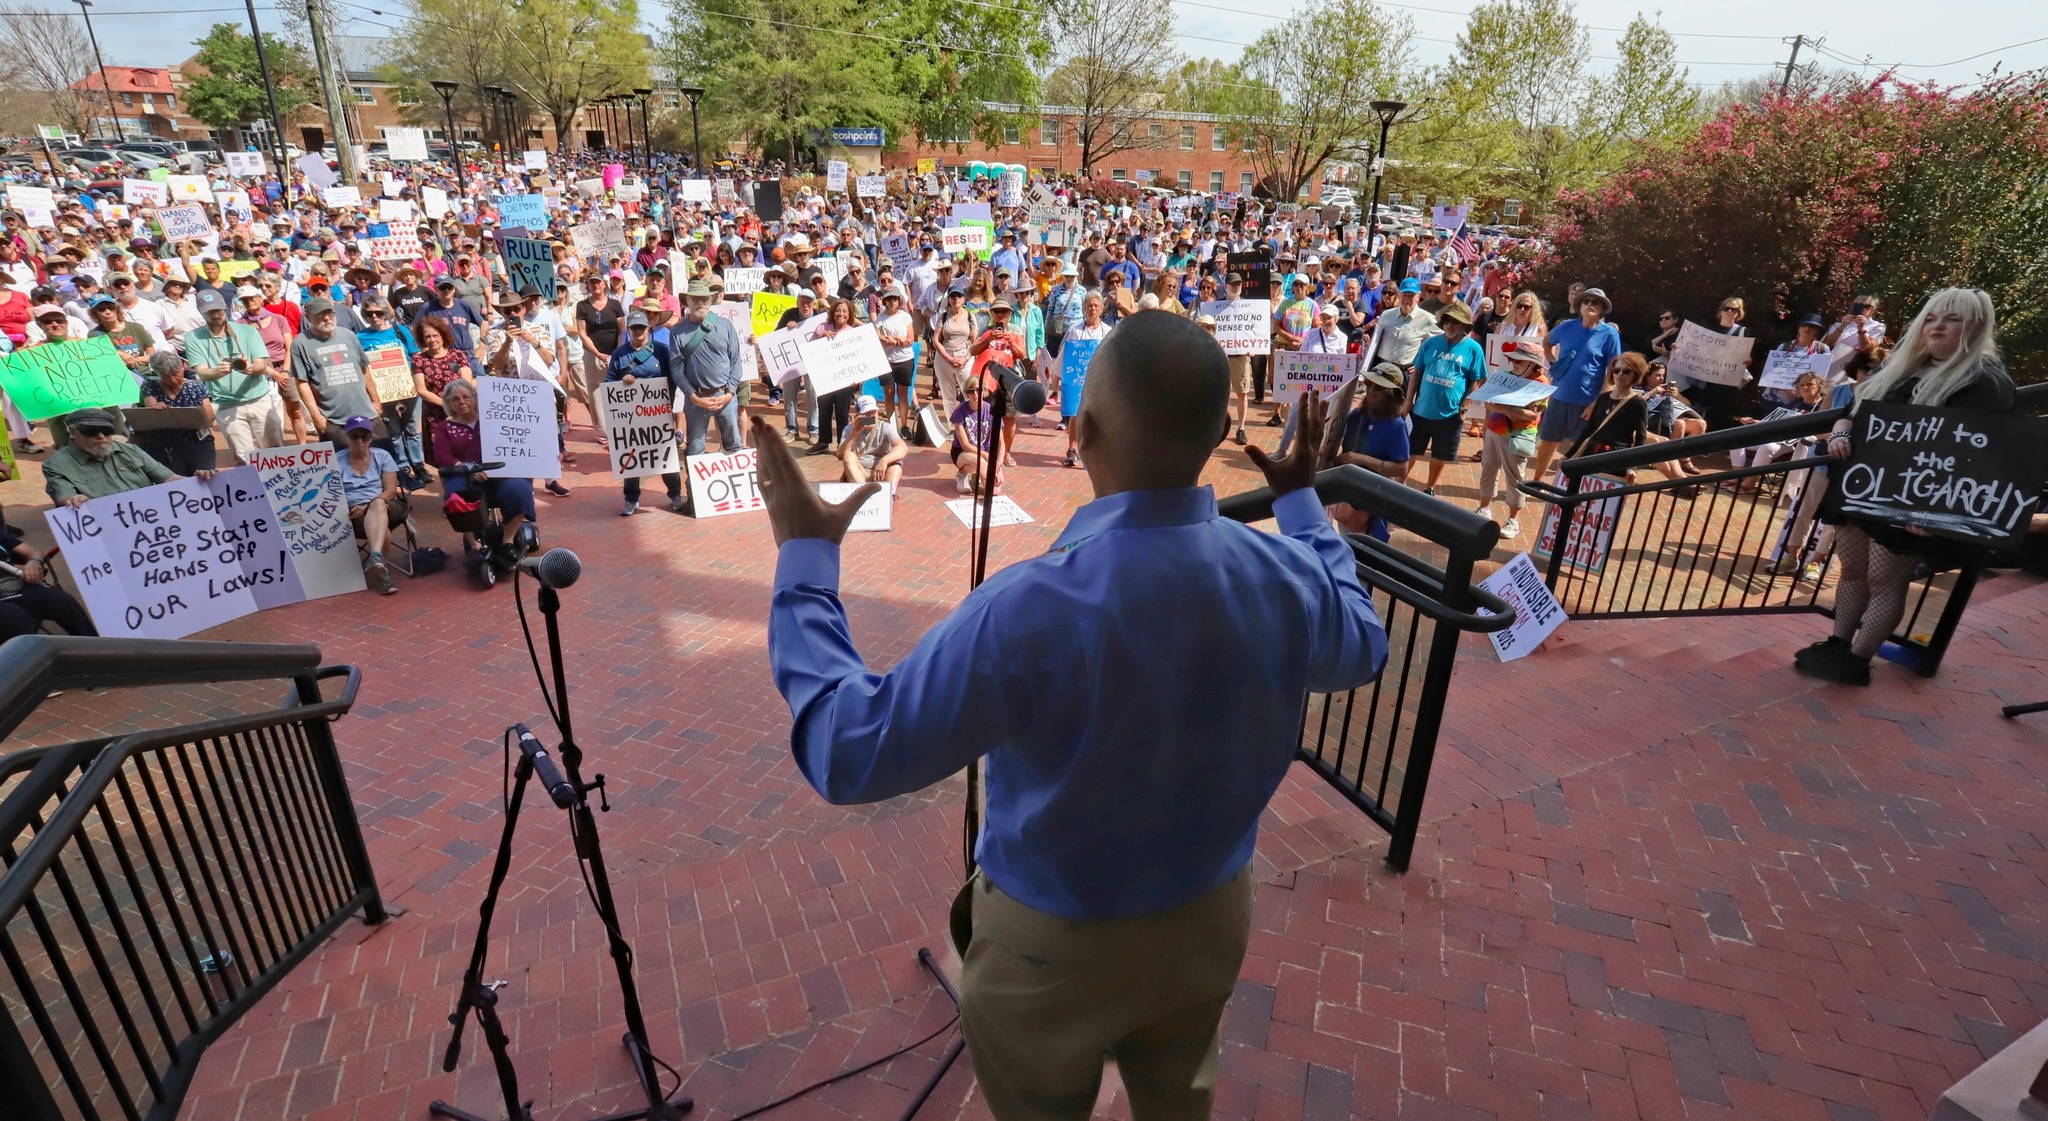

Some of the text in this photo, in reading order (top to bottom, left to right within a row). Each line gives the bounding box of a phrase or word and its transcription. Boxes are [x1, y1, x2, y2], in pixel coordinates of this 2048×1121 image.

[833, 130, 878, 142] cashpoints
[132, 191, 158, 199] NATO
[1000, 198, 1019, 206] VOTE
[161, 208, 196, 219] HANDS
[505, 203, 538, 213] DEPORT
[1031, 205, 1056, 215] HANDS
[169, 223, 207, 237] EDUCATION
[511, 218, 543, 227] FRIENDS
[945, 234, 983, 245] RESIST
[506, 240, 552, 261] RULE
[524, 264, 539, 275] of
[1230, 262, 1268, 270] DIVERSITY
[511, 273, 554, 298] LAW
[402, 297, 424, 305] Resist.
[1682, 321, 1727, 347] Morons
[1678, 335, 1700, 351] Are
[1, 335, 115, 375] KINDNESS
[1438, 351, 1454, 361] AM
[1456, 355, 1463, 364] A
[1674, 347, 1737, 372] Governing
[45, 358, 96, 383] NOT
[833, 363, 868, 381] AMERICA
[1322, 364, 1339, 372] THE
[379, 380, 405, 390] LIBERTY
[1287, 373, 1343, 382] DEMOLITION
[1488, 371, 1521, 389] HANDS
[33, 371, 127, 405] CRUELTY
[382, 392, 396, 400] FOR
[492, 382, 538, 394] HANDS
[606, 383, 670, 405] KEEP YOUR
[502, 395, 527, 404] OFF
[489, 402, 537, 414] SOCIAL
[635, 403, 672, 417] ORANGE
[486, 411, 541, 423] SECURITY
[500, 426, 531, 437] STOP
[612, 423, 675, 450] HANDS
[1866, 414, 1989, 448] DEATH to
[493, 446, 537, 457] STEAL
[249, 449, 333, 472] HANDS OFF
[694, 451, 757, 481] HANDS
[1913, 451, 1956, 472] the
[263, 465, 327, 491] ATER Protection
[1561, 475, 1615, 492] HNDS
[274, 478, 300, 500] RULES
[1842, 463, 2039, 530] OLIGARCHY
[301, 520, 324, 539] ALL
[327, 469, 344, 503] WATERS
[53, 510, 102, 544] We
[113, 501, 160, 528] the
[329, 519, 342, 534] and
[81, 561, 113, 586] The
[197, 517, 268, 551] State
[144, 560, 208, 587] Hands
[1512, 564, 1558, 626] INDIVISIBLE
[1498, 583, 1531, 630] CHATHAM
